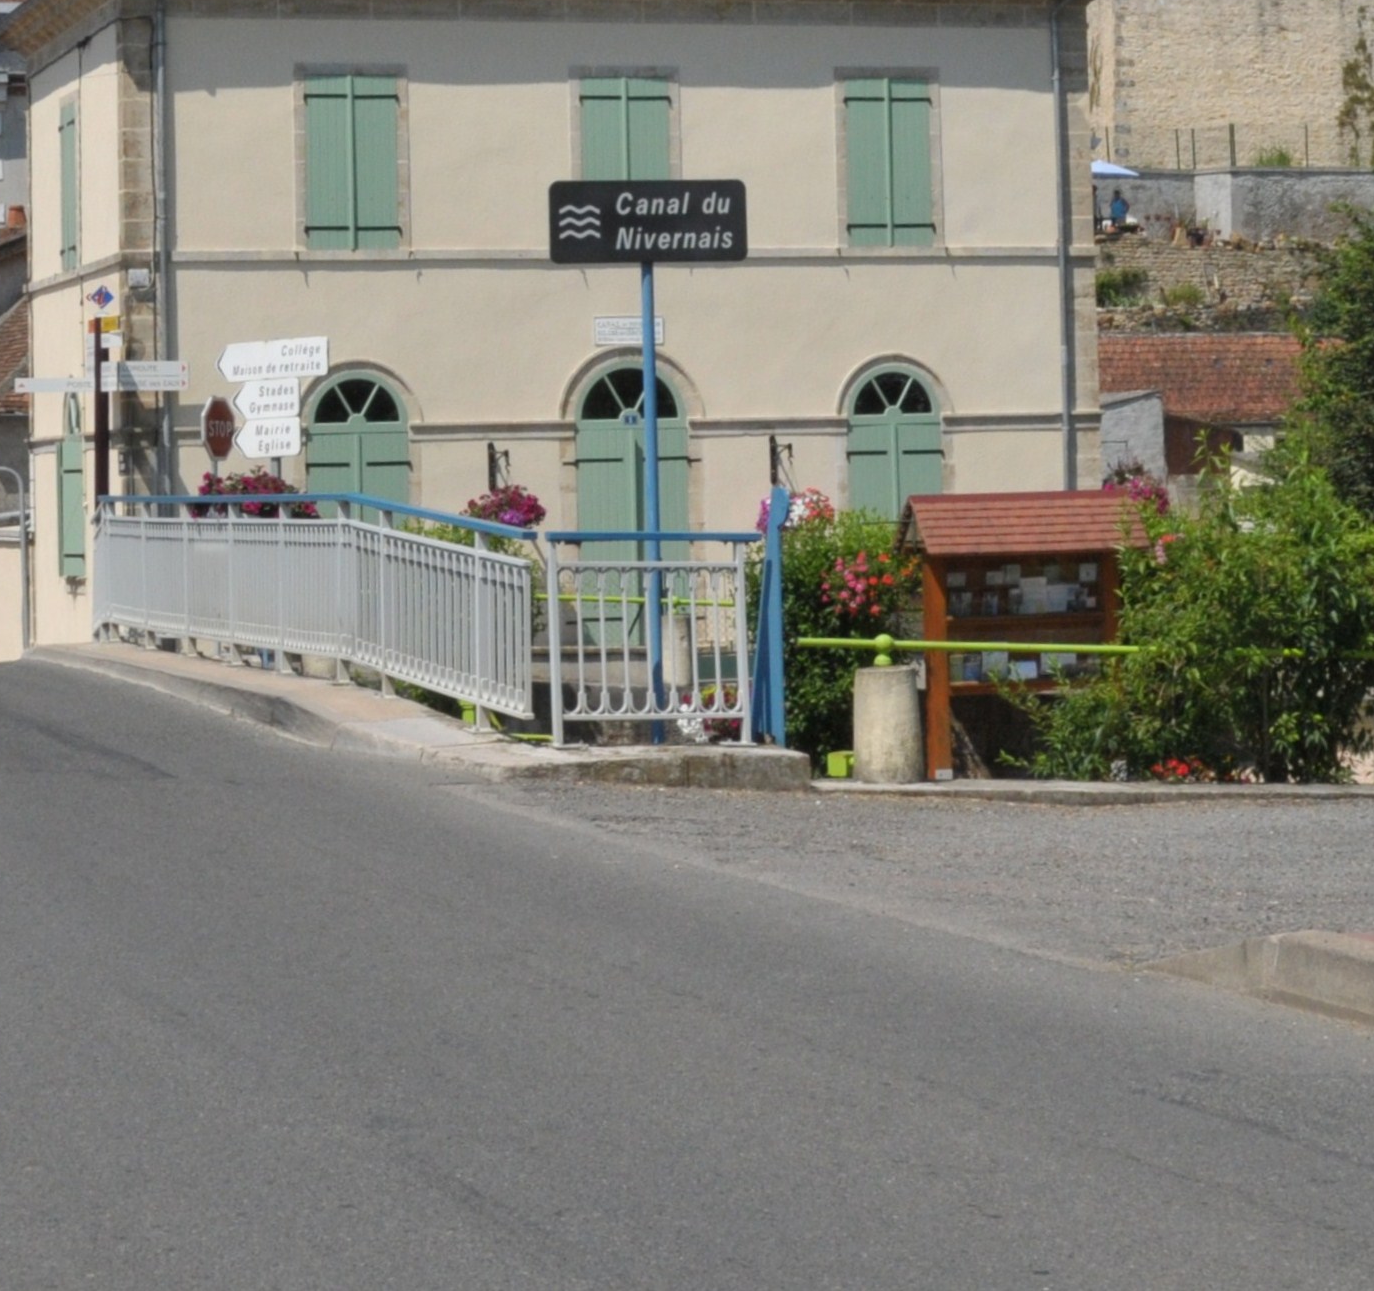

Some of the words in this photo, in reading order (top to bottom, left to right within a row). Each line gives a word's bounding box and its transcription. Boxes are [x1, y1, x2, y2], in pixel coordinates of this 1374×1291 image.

[615, 191, 690, 216] Canal
[701, 191, 731, 215] du
[615, 226, 734, 251] Nivernais
[281, 344, 321, 358] Collège
[232, 365, 264, 376] Maison
[266, 362, 276, 373] de
[279, 360, 321, 373] retraite
[66, 380, 92, 389] POSTE
[259, 385, 294, 397] Stades
[249, 401, 295, 415] Gymnase
[208, 419, 233, 438] STOP
[255, 424, 291, 437] Mairie
[258, 439, 292, 454] Eglise
